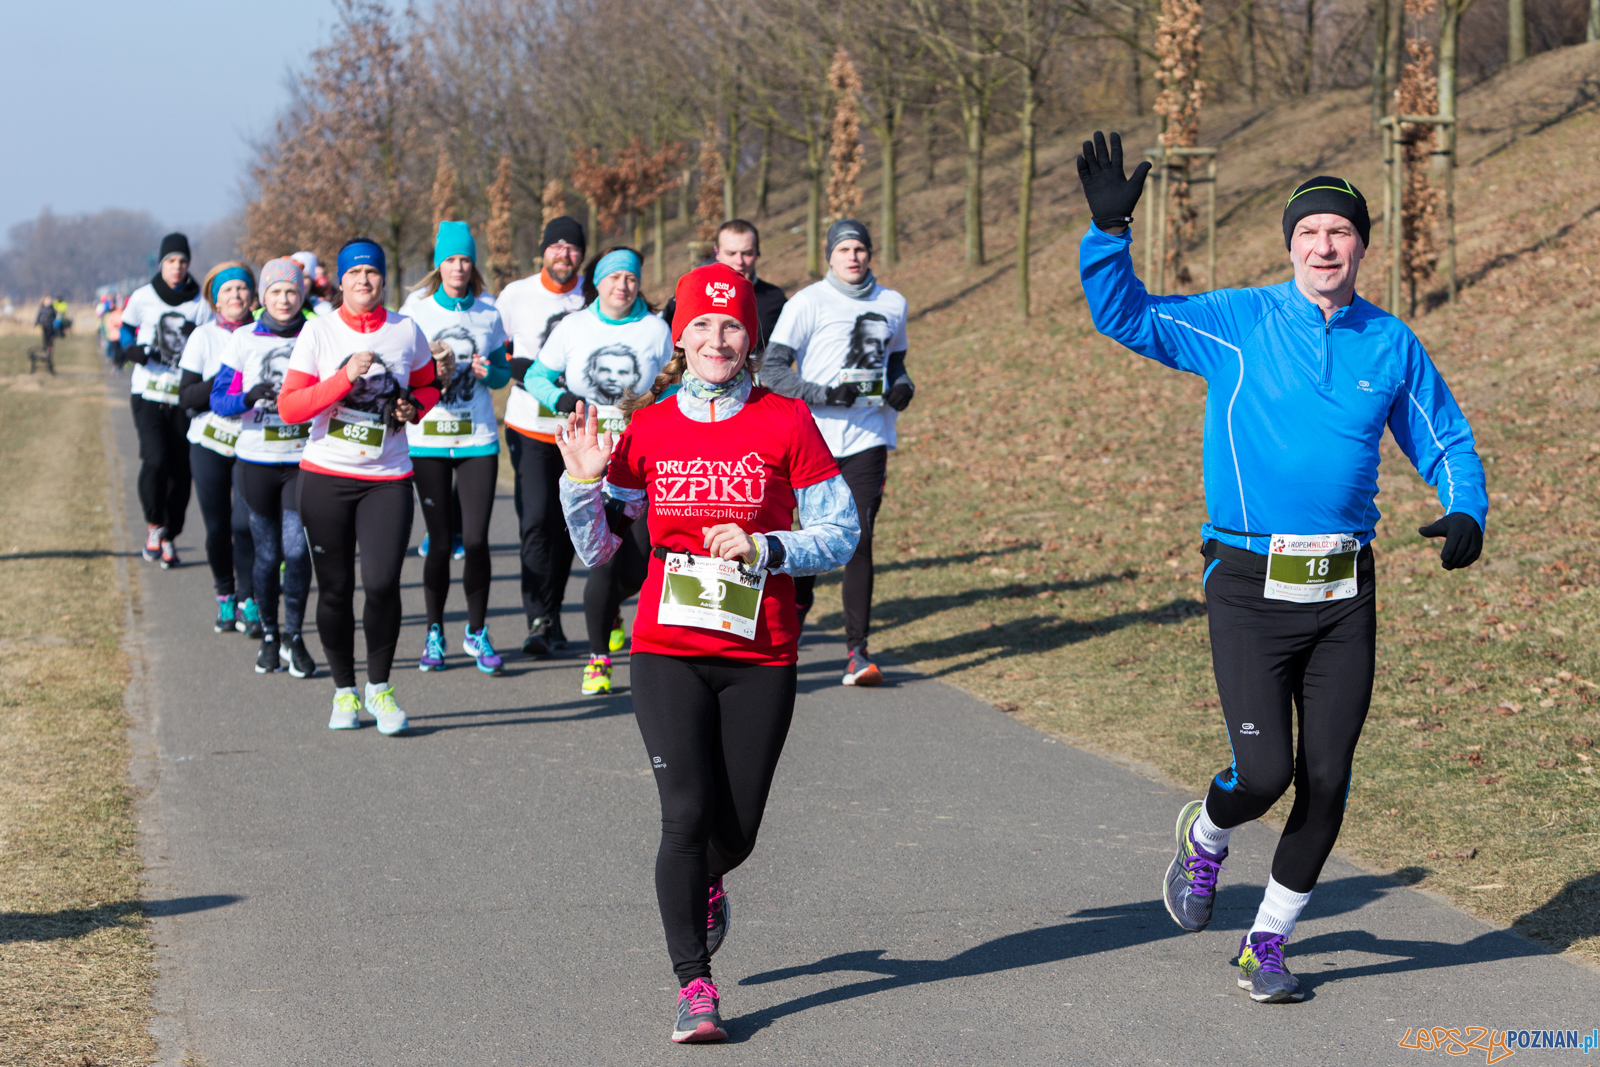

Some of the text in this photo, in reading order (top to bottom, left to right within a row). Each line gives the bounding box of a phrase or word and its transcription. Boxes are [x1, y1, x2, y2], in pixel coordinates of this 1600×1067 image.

[343, 424, 369, 440] 652
[436, 421, 459, 433] 883
[602, 419, 627, 432] 466
[656, 457, 747, 476] DRUŻYNA
[655, 476, 766, 503] SZPIKU
[656, 506, 758, 521] www.darszpiku.pl
[1305, 558, 1330, 576] 18
[698, 581, 727, 602] 20
